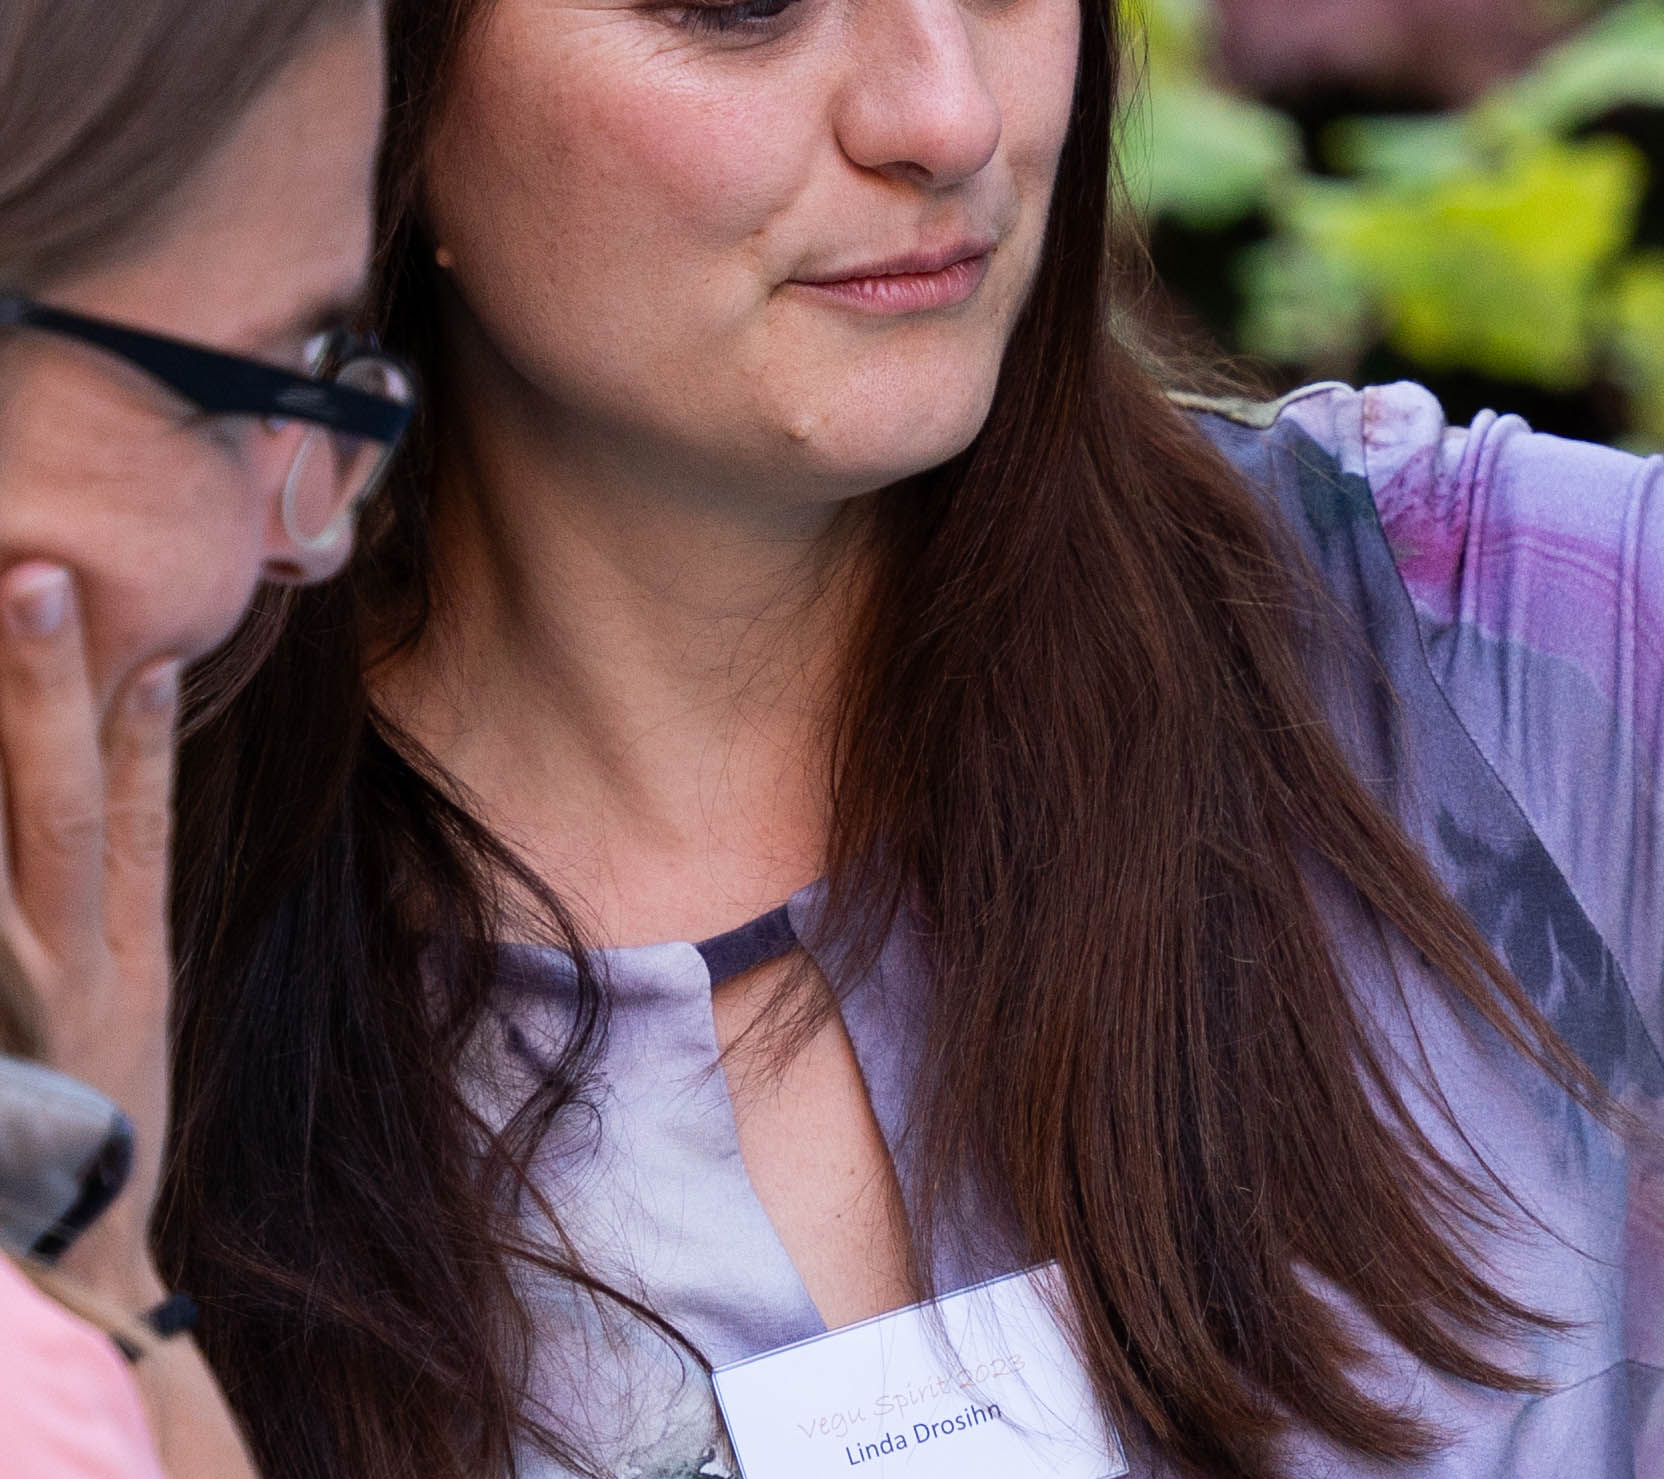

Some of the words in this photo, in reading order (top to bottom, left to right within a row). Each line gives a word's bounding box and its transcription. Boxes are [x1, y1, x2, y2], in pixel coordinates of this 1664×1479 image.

[872, 1376, 951, 1419] Spirit
[956, 1354, 1027, 1390] 2023
[845, 1433, 908, 1466] Linda
[912, 1402, 1002, 1444] Drosihn
